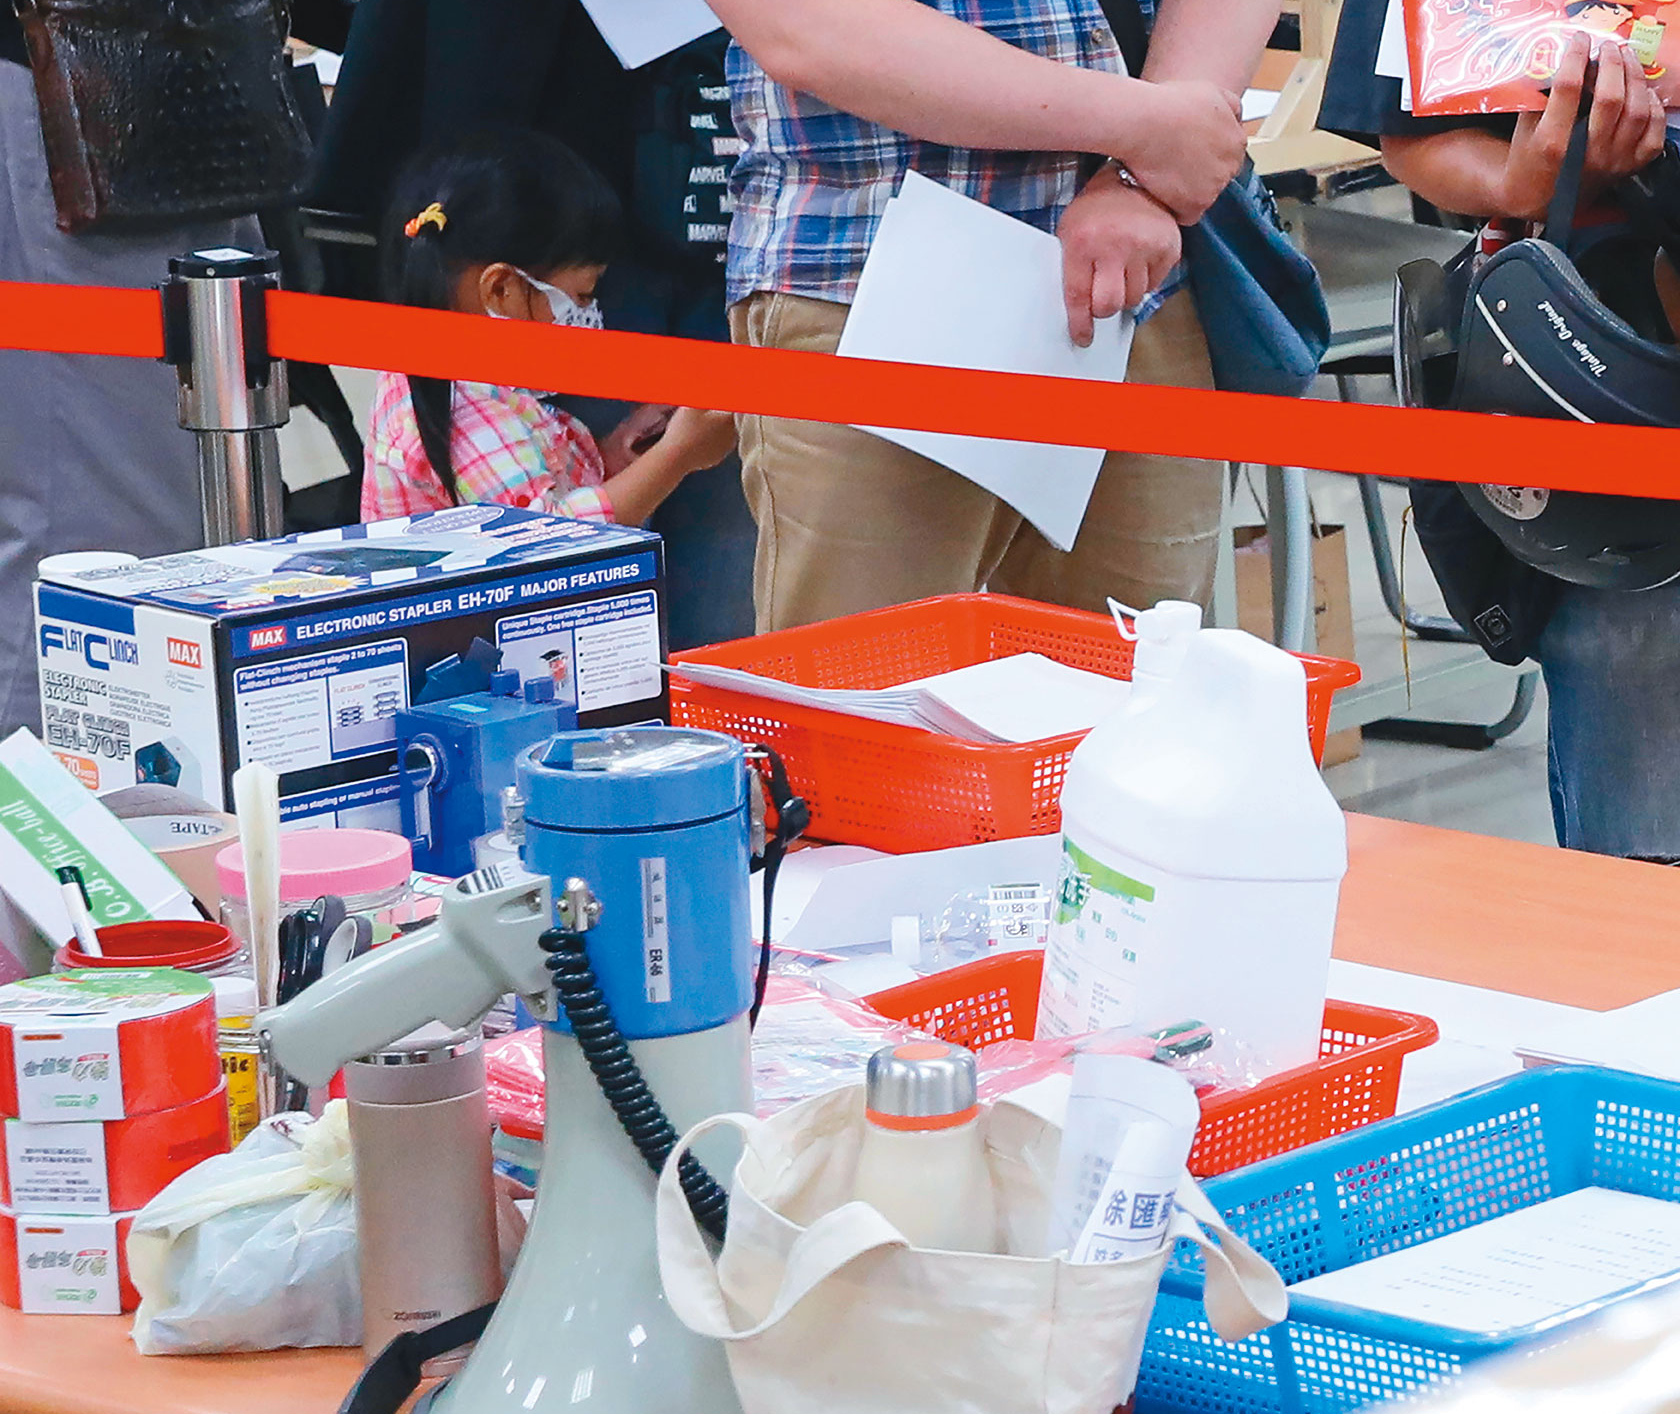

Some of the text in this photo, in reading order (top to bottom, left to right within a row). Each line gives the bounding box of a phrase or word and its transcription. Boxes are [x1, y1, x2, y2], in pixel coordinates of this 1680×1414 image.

[251, 563, 640, 649] MAX ELECTRONIC STAPLER EH-70F MAJOR FEATURES
[40, 623, 139, 671] FLAT CLINCH
[168, 641, 201, 667] MAX
[42, 669, 107, 697] ELECTRONIC
[43, 687, 88, 707] STAPLER
[47, 724, 131, 761] EH-70F
[170, 820, 208, 836] TAPE
[648, 948, 663, 976] ER-66
